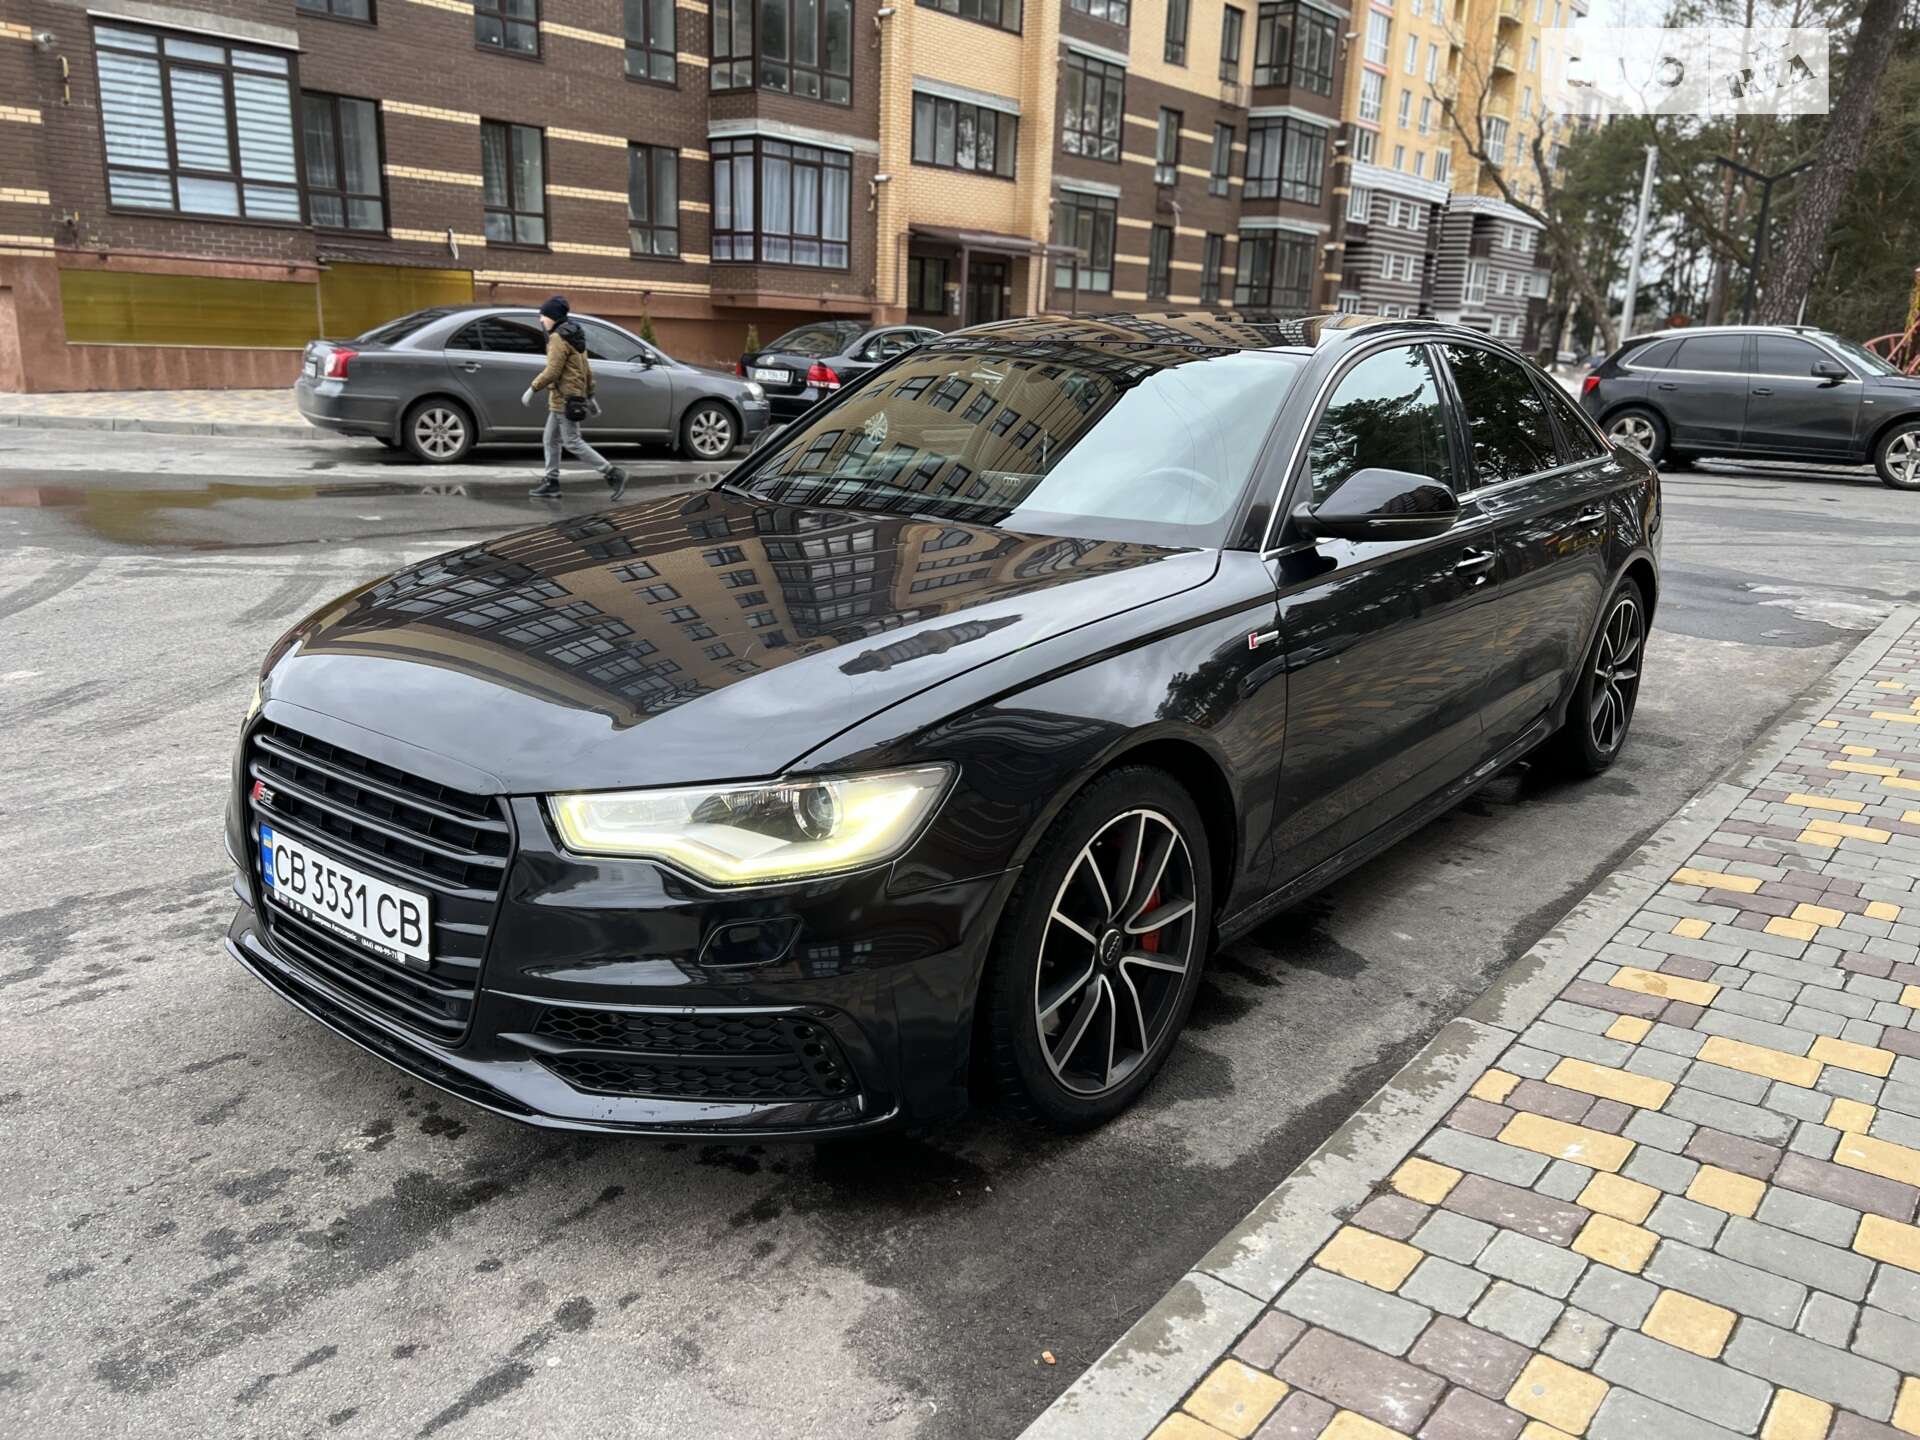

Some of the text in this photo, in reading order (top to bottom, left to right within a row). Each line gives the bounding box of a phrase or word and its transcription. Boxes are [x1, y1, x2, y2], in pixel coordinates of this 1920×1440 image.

[275, 844, 306, 895] CB
[311, 860, 368, 929] 3531
[377, 893, 423, 948] CB
